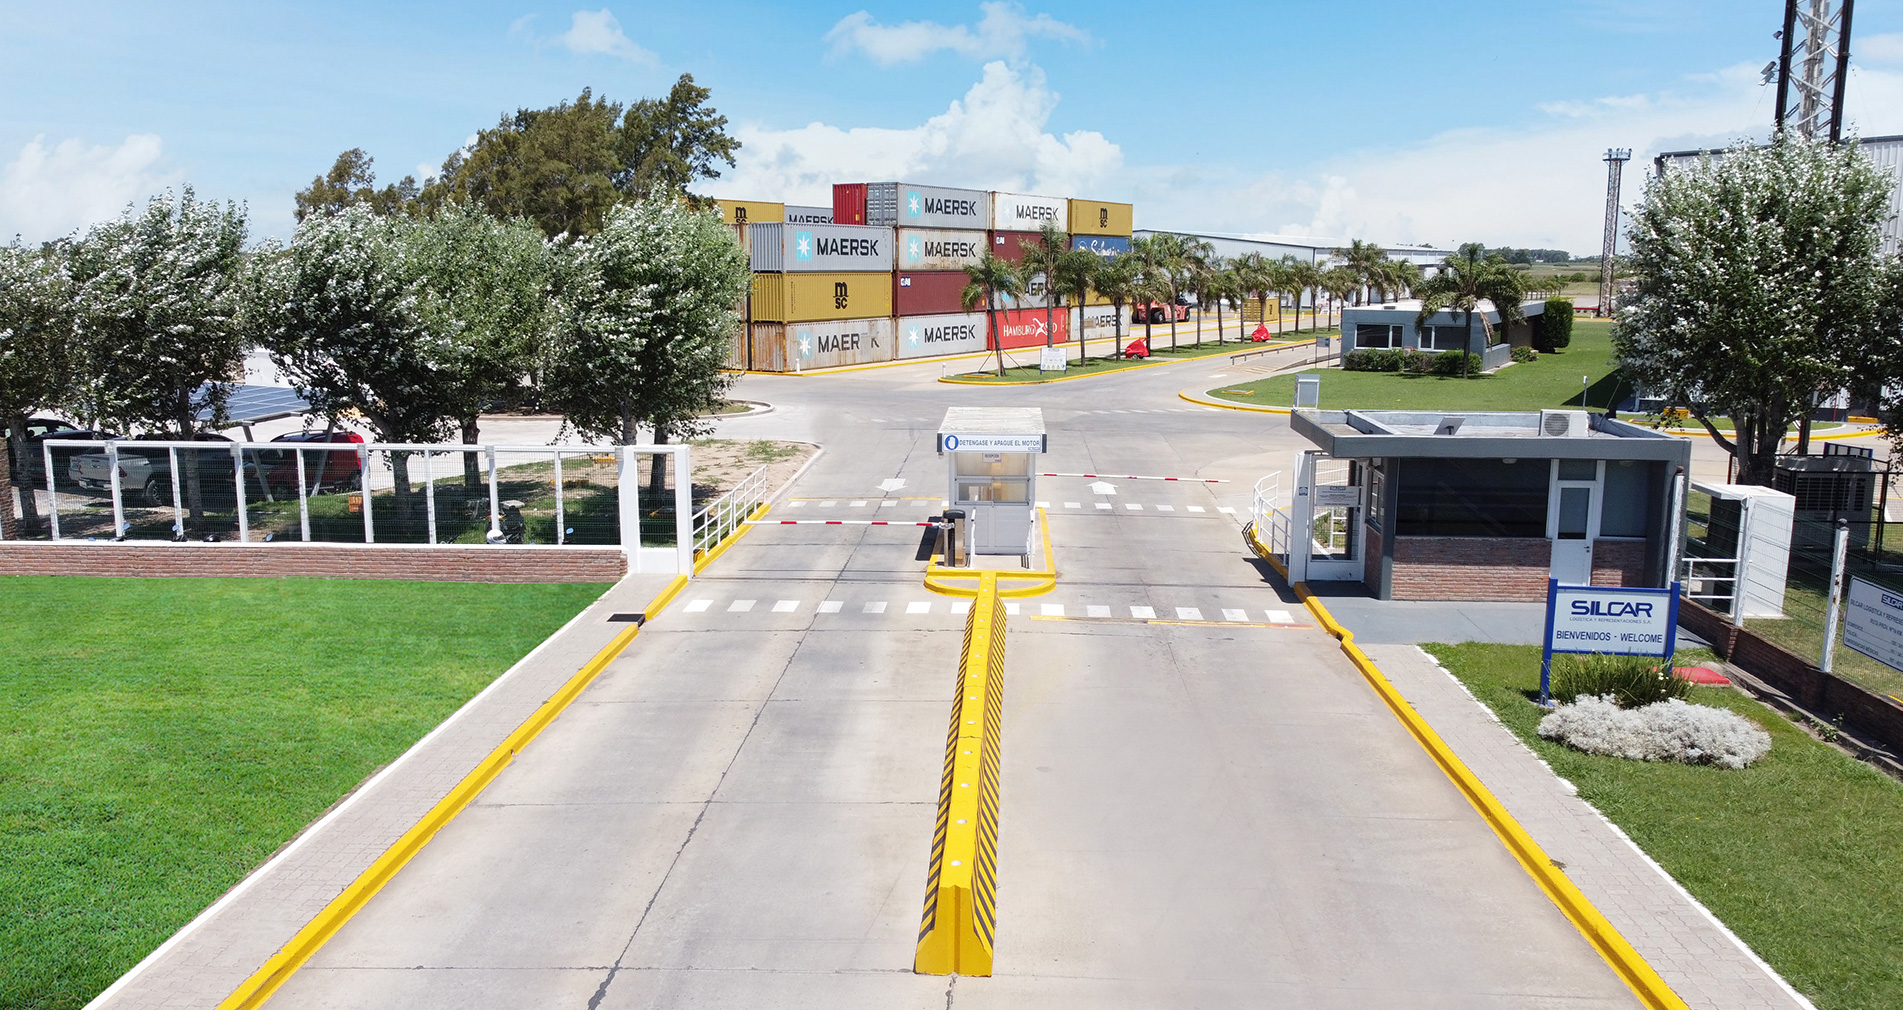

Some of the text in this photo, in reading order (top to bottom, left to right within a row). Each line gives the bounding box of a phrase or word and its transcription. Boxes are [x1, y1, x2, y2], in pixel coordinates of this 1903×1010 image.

[924, 197, 977, 216] MAERSK
[1016, 204, 1059, 221] MAERSK
[816, 237, 879, 256] MAERSK
[924, 241, 977, 258] MAERSK
[924, 324, 976, 343] MAERSK
[1003, 324, 1037, 337] HAMBURG
[817, 332, 880, 354] MAERK
[993, 439, 1013, 447] APAGUE
[1014, 439, 1021, 447] EL
[1571, 599, 1654, 618] SILCAR
[1556, 630, 1611, 641] BIENVENIDOS
[1620, 632, 1663, 643] WELCOME
